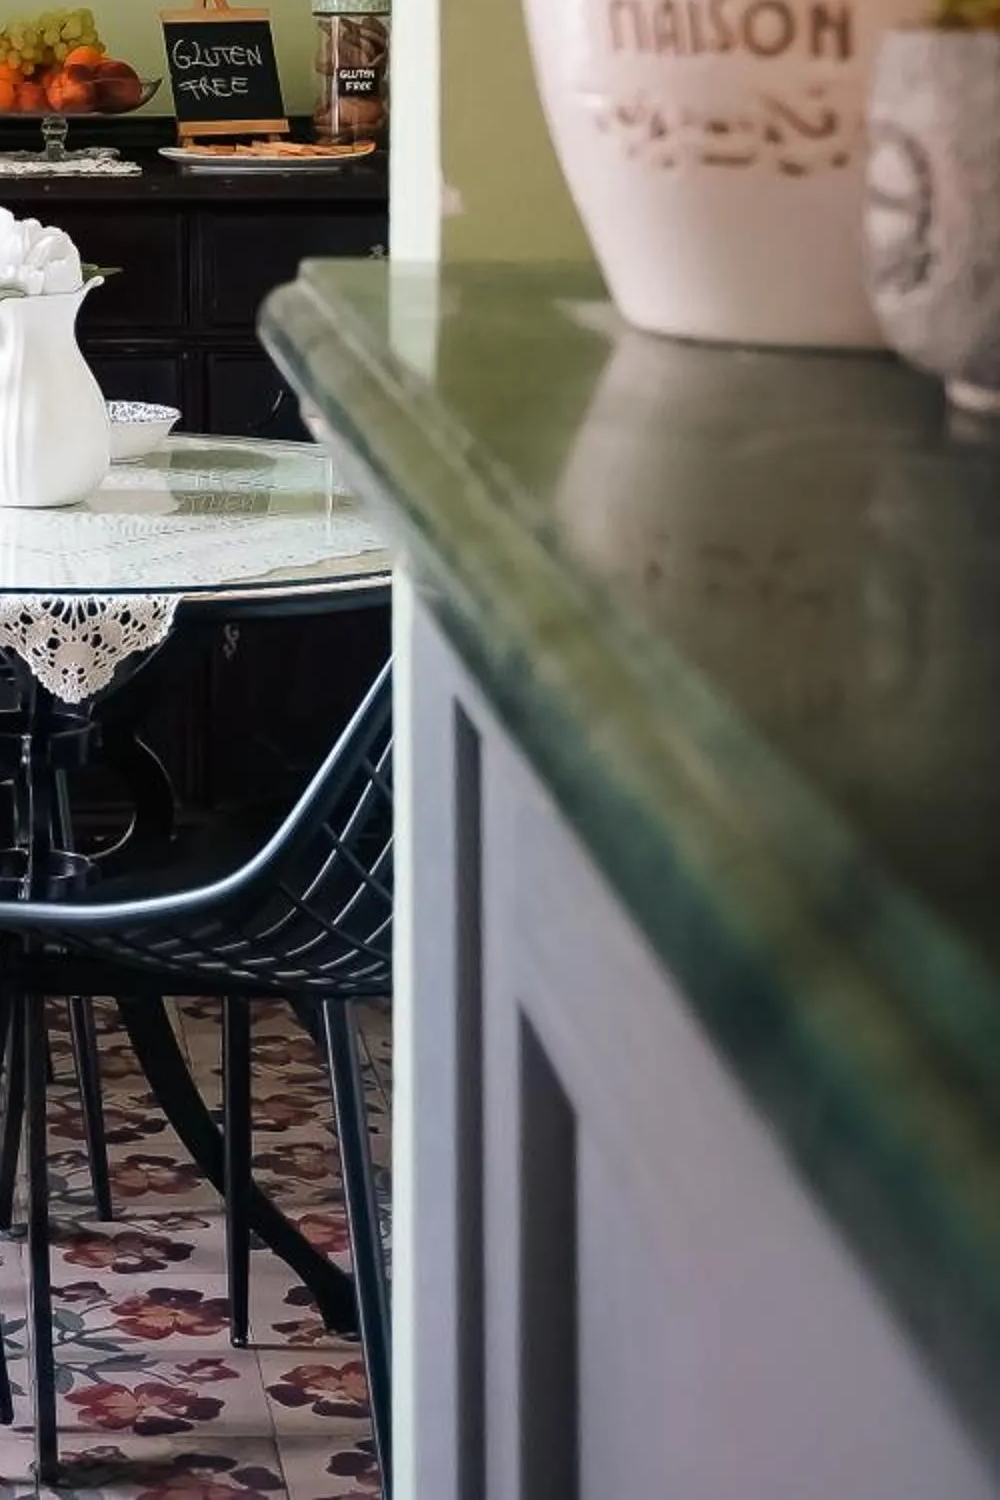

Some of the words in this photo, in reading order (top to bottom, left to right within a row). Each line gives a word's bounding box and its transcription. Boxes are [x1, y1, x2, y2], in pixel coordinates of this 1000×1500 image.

[172, 39, 264, 70] GLUTEN
[339, 69, 375, 79] GLUTEN
[178, 76, 250, 101] FREE
[345, 81, 373, 91] FREE
